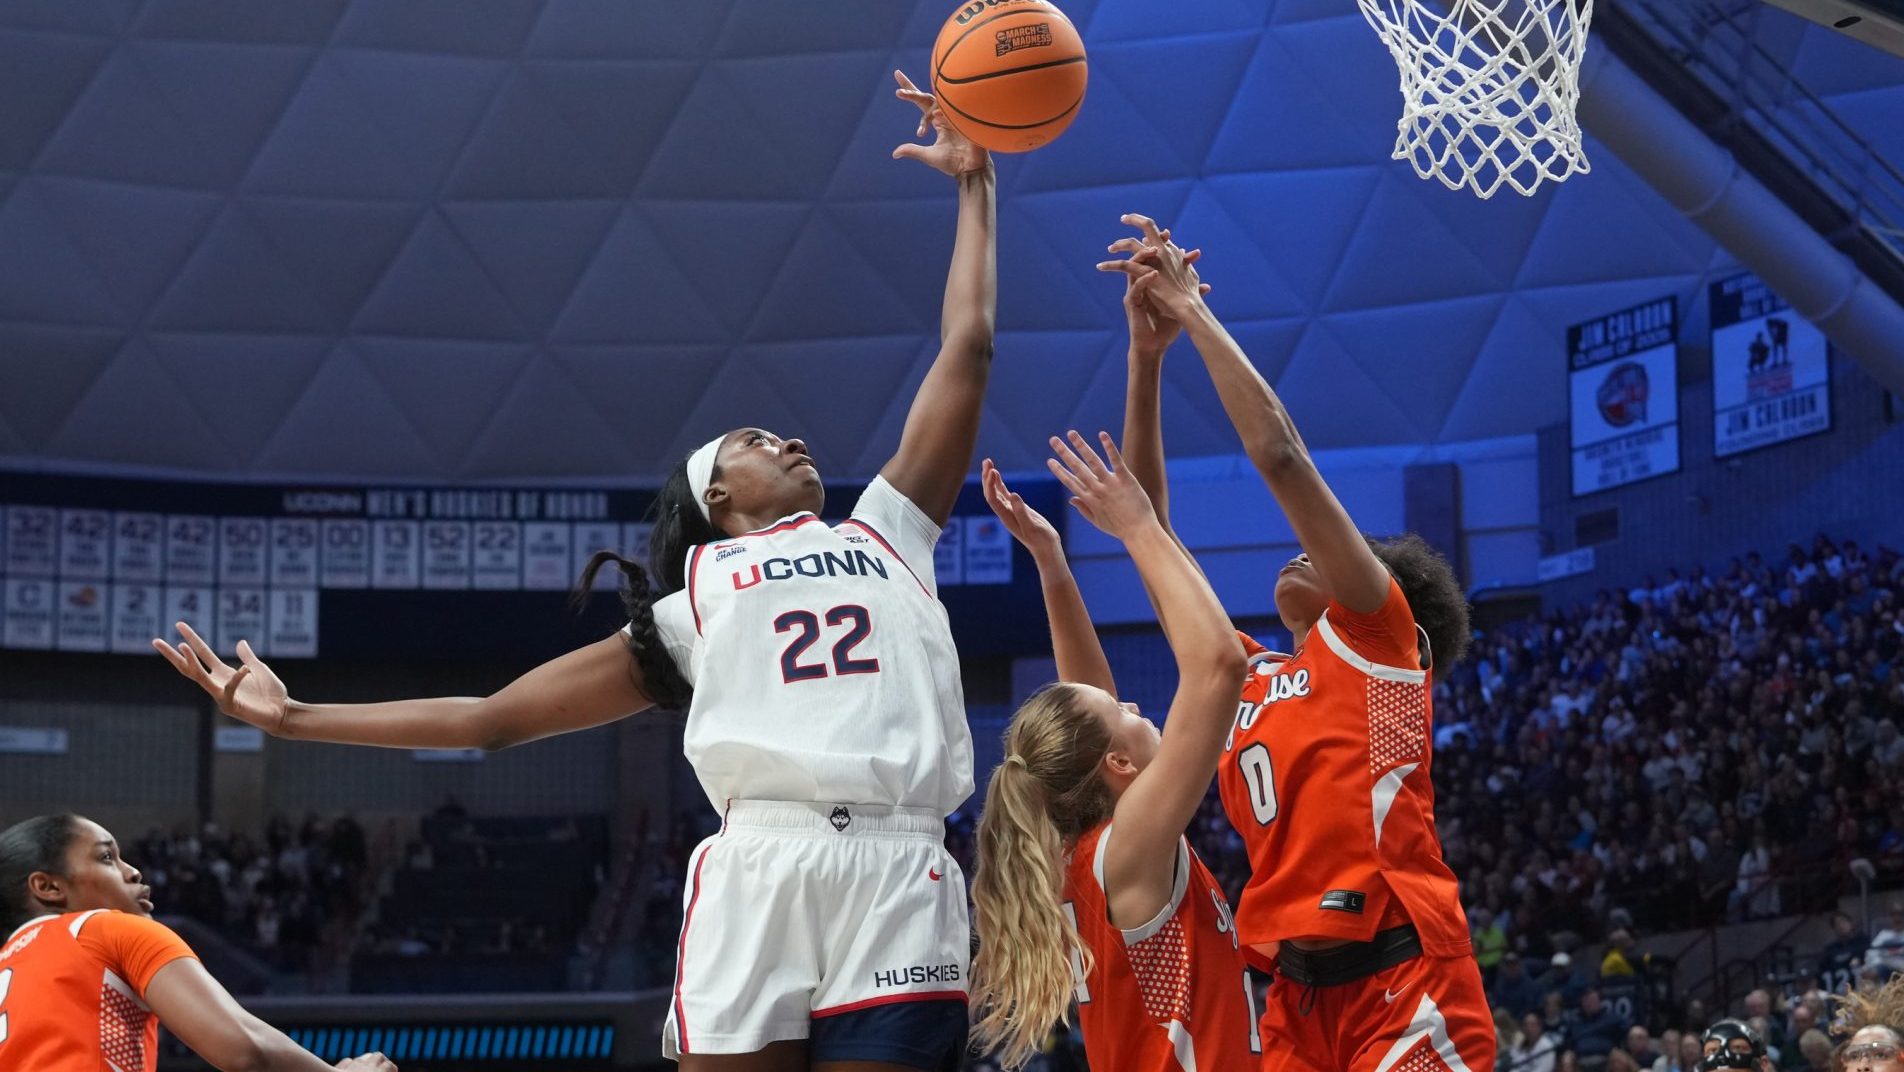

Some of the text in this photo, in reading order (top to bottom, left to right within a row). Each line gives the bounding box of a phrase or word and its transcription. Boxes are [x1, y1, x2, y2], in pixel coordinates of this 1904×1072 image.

[1006, 26, 1036, 38] MARCH
[1012, 34, 1052, 47] MADNESS
[276, 524, 314, 548] 25
[326, 525, 363, 548] 00
[428, 526, 466, 549] 52
[477, 526, 516, 549] 22
[732, 550, 889, 590] UCONN
[773, 604, 880, 684] 22
[1238, 741, 1278, 827] 0
[874, 964, 960, 987] HUSKIES
